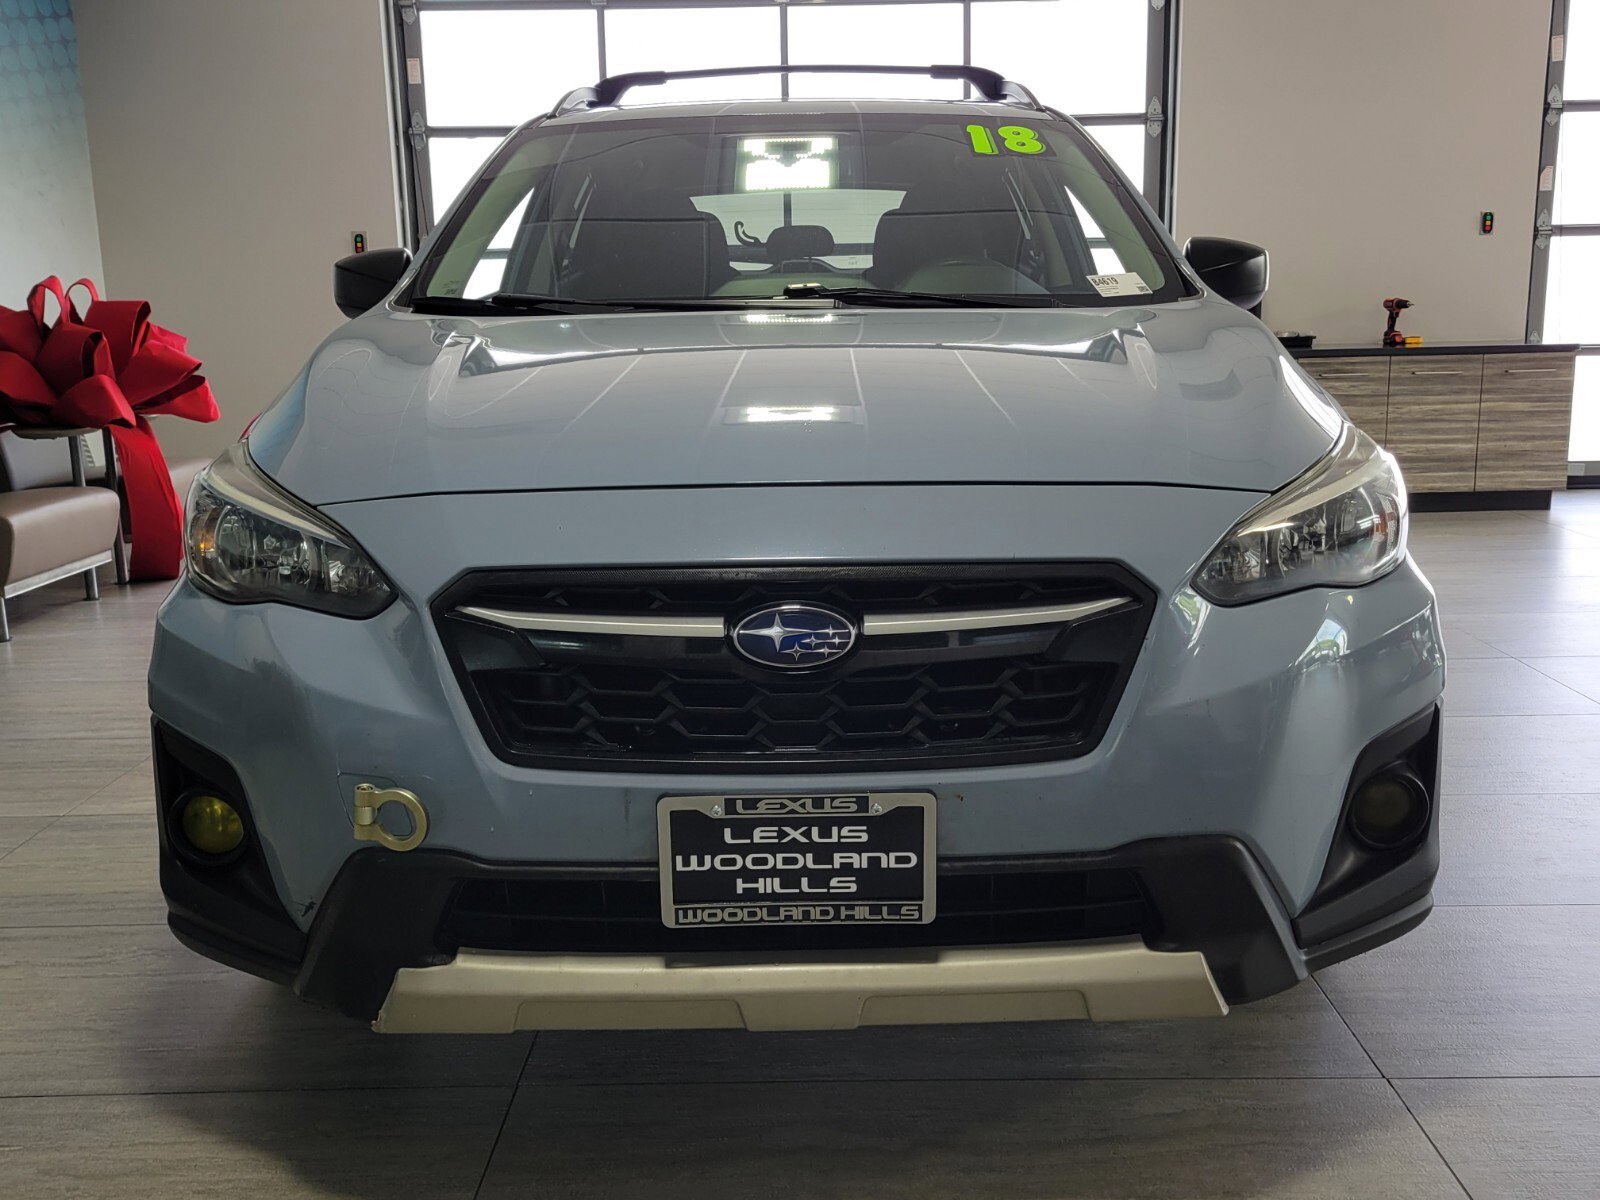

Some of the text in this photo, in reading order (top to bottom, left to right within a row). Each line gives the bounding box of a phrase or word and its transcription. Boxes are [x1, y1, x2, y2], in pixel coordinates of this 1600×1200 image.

[966, 124, 1047, 155] 18
[735, 798, 858, 814] LEXUS
[724, 826, 869, 843] LEXUS
[675, 852, 918, 871] WOODLAND
[736, 877, 858, 894] HILLS
[678, 905, 920, 924] WOODLAND HILLS
